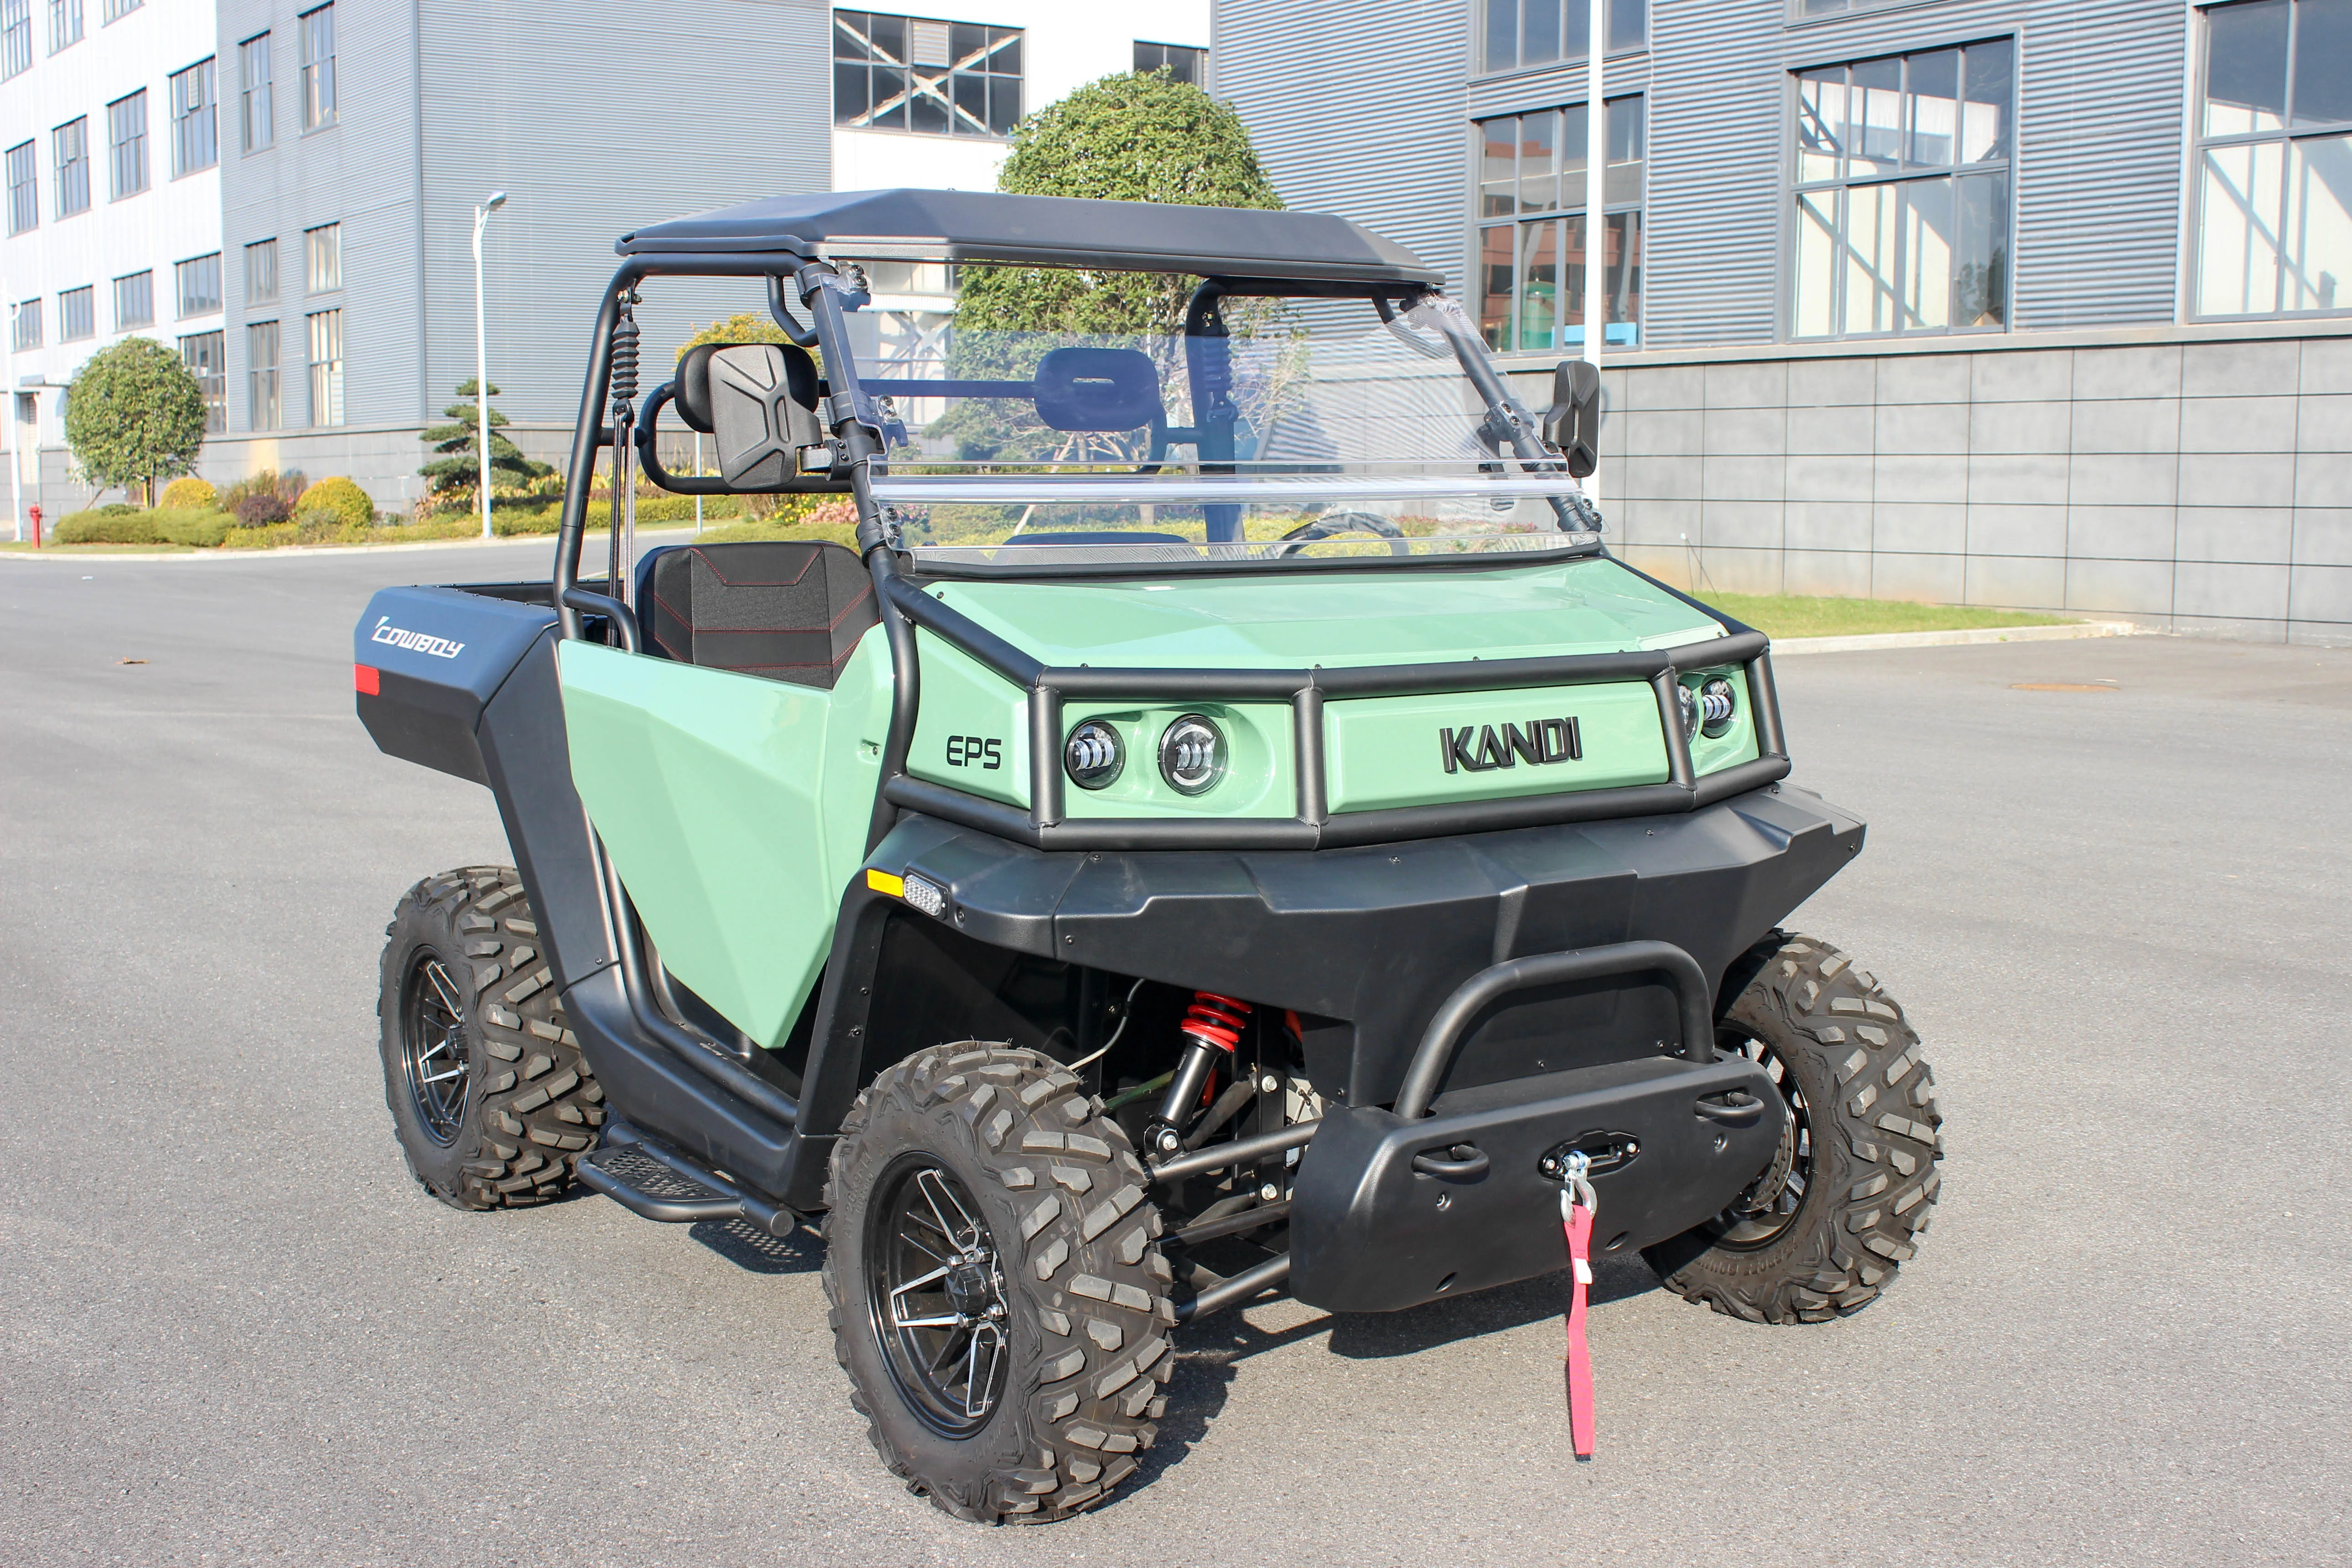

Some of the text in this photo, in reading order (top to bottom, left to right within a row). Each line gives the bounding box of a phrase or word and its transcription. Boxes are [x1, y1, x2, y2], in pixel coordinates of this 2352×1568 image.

[371, 616, 465, 659] COWBOY
[946, 735, 1002, 770] EPS
[1439, 716, 1582, 774] KANDI
